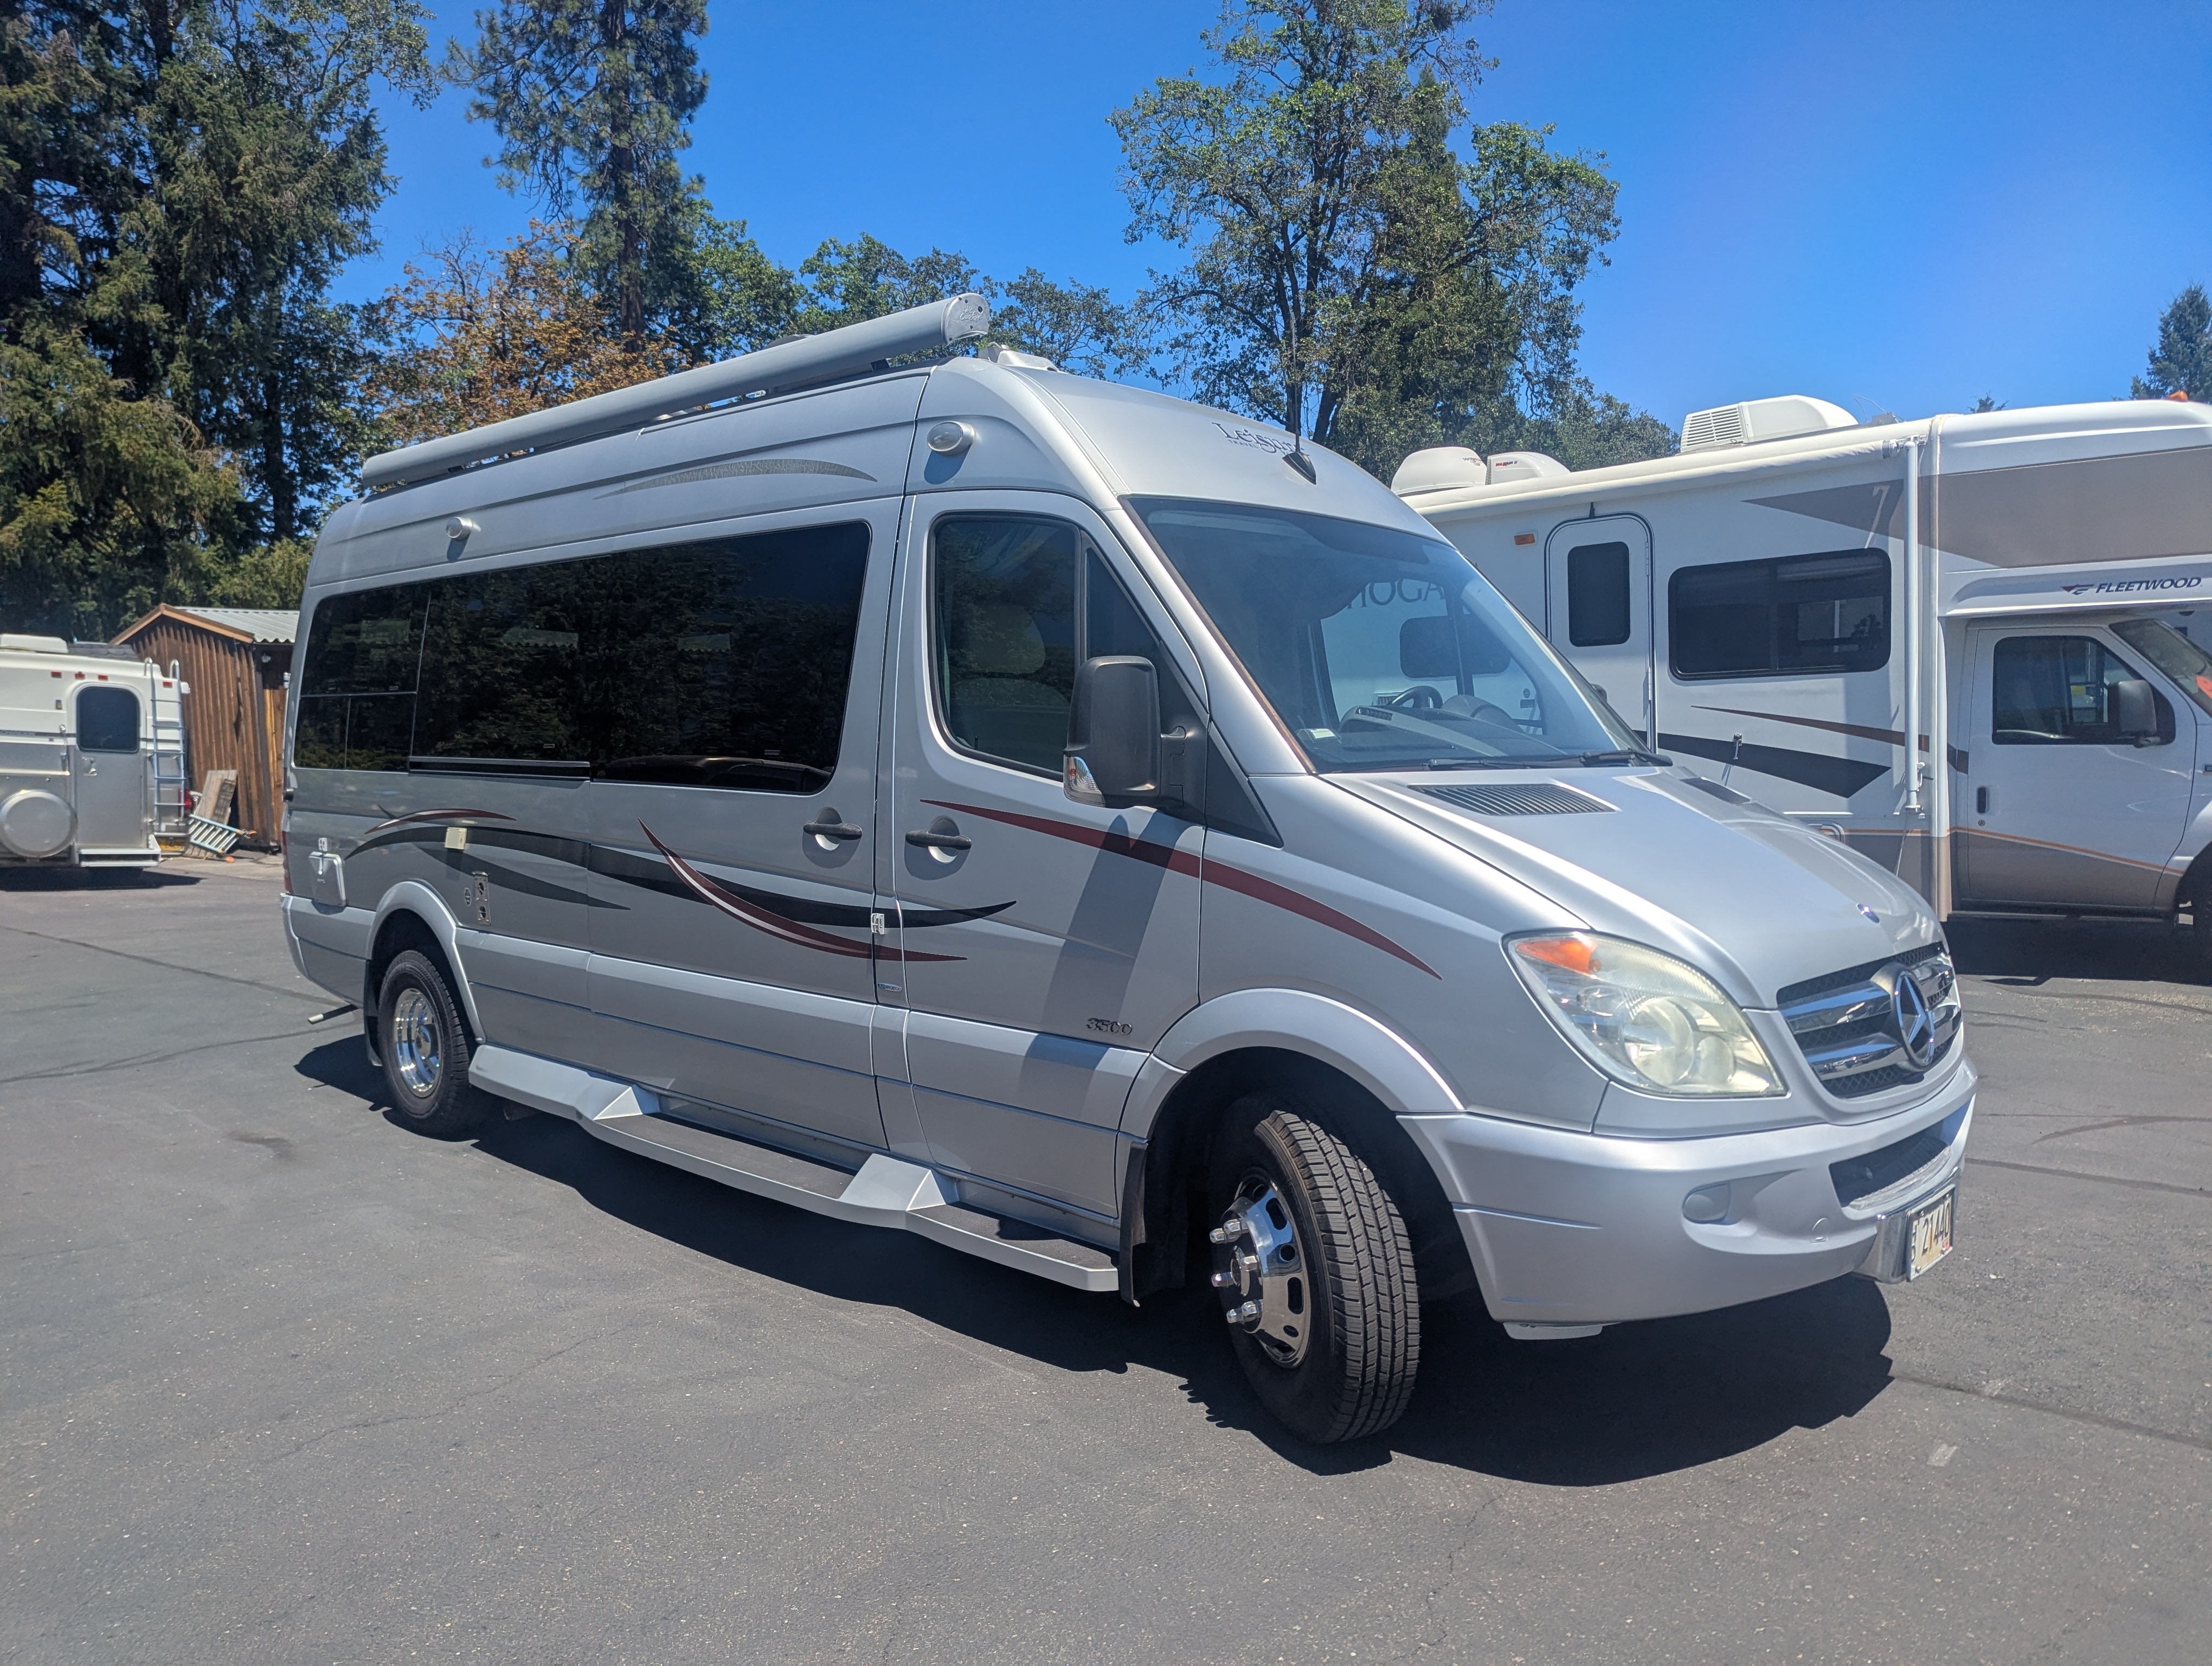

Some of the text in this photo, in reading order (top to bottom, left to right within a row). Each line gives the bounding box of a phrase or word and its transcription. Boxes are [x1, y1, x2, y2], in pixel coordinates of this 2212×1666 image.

[1228, 439, 1259, 449] TRAVEL
[2095, 577, 2202, 594] FLEETWOOD
[1085, 1017, 1133, 1035] 3500
[1922, 1202, 1950, 1257] 21440
